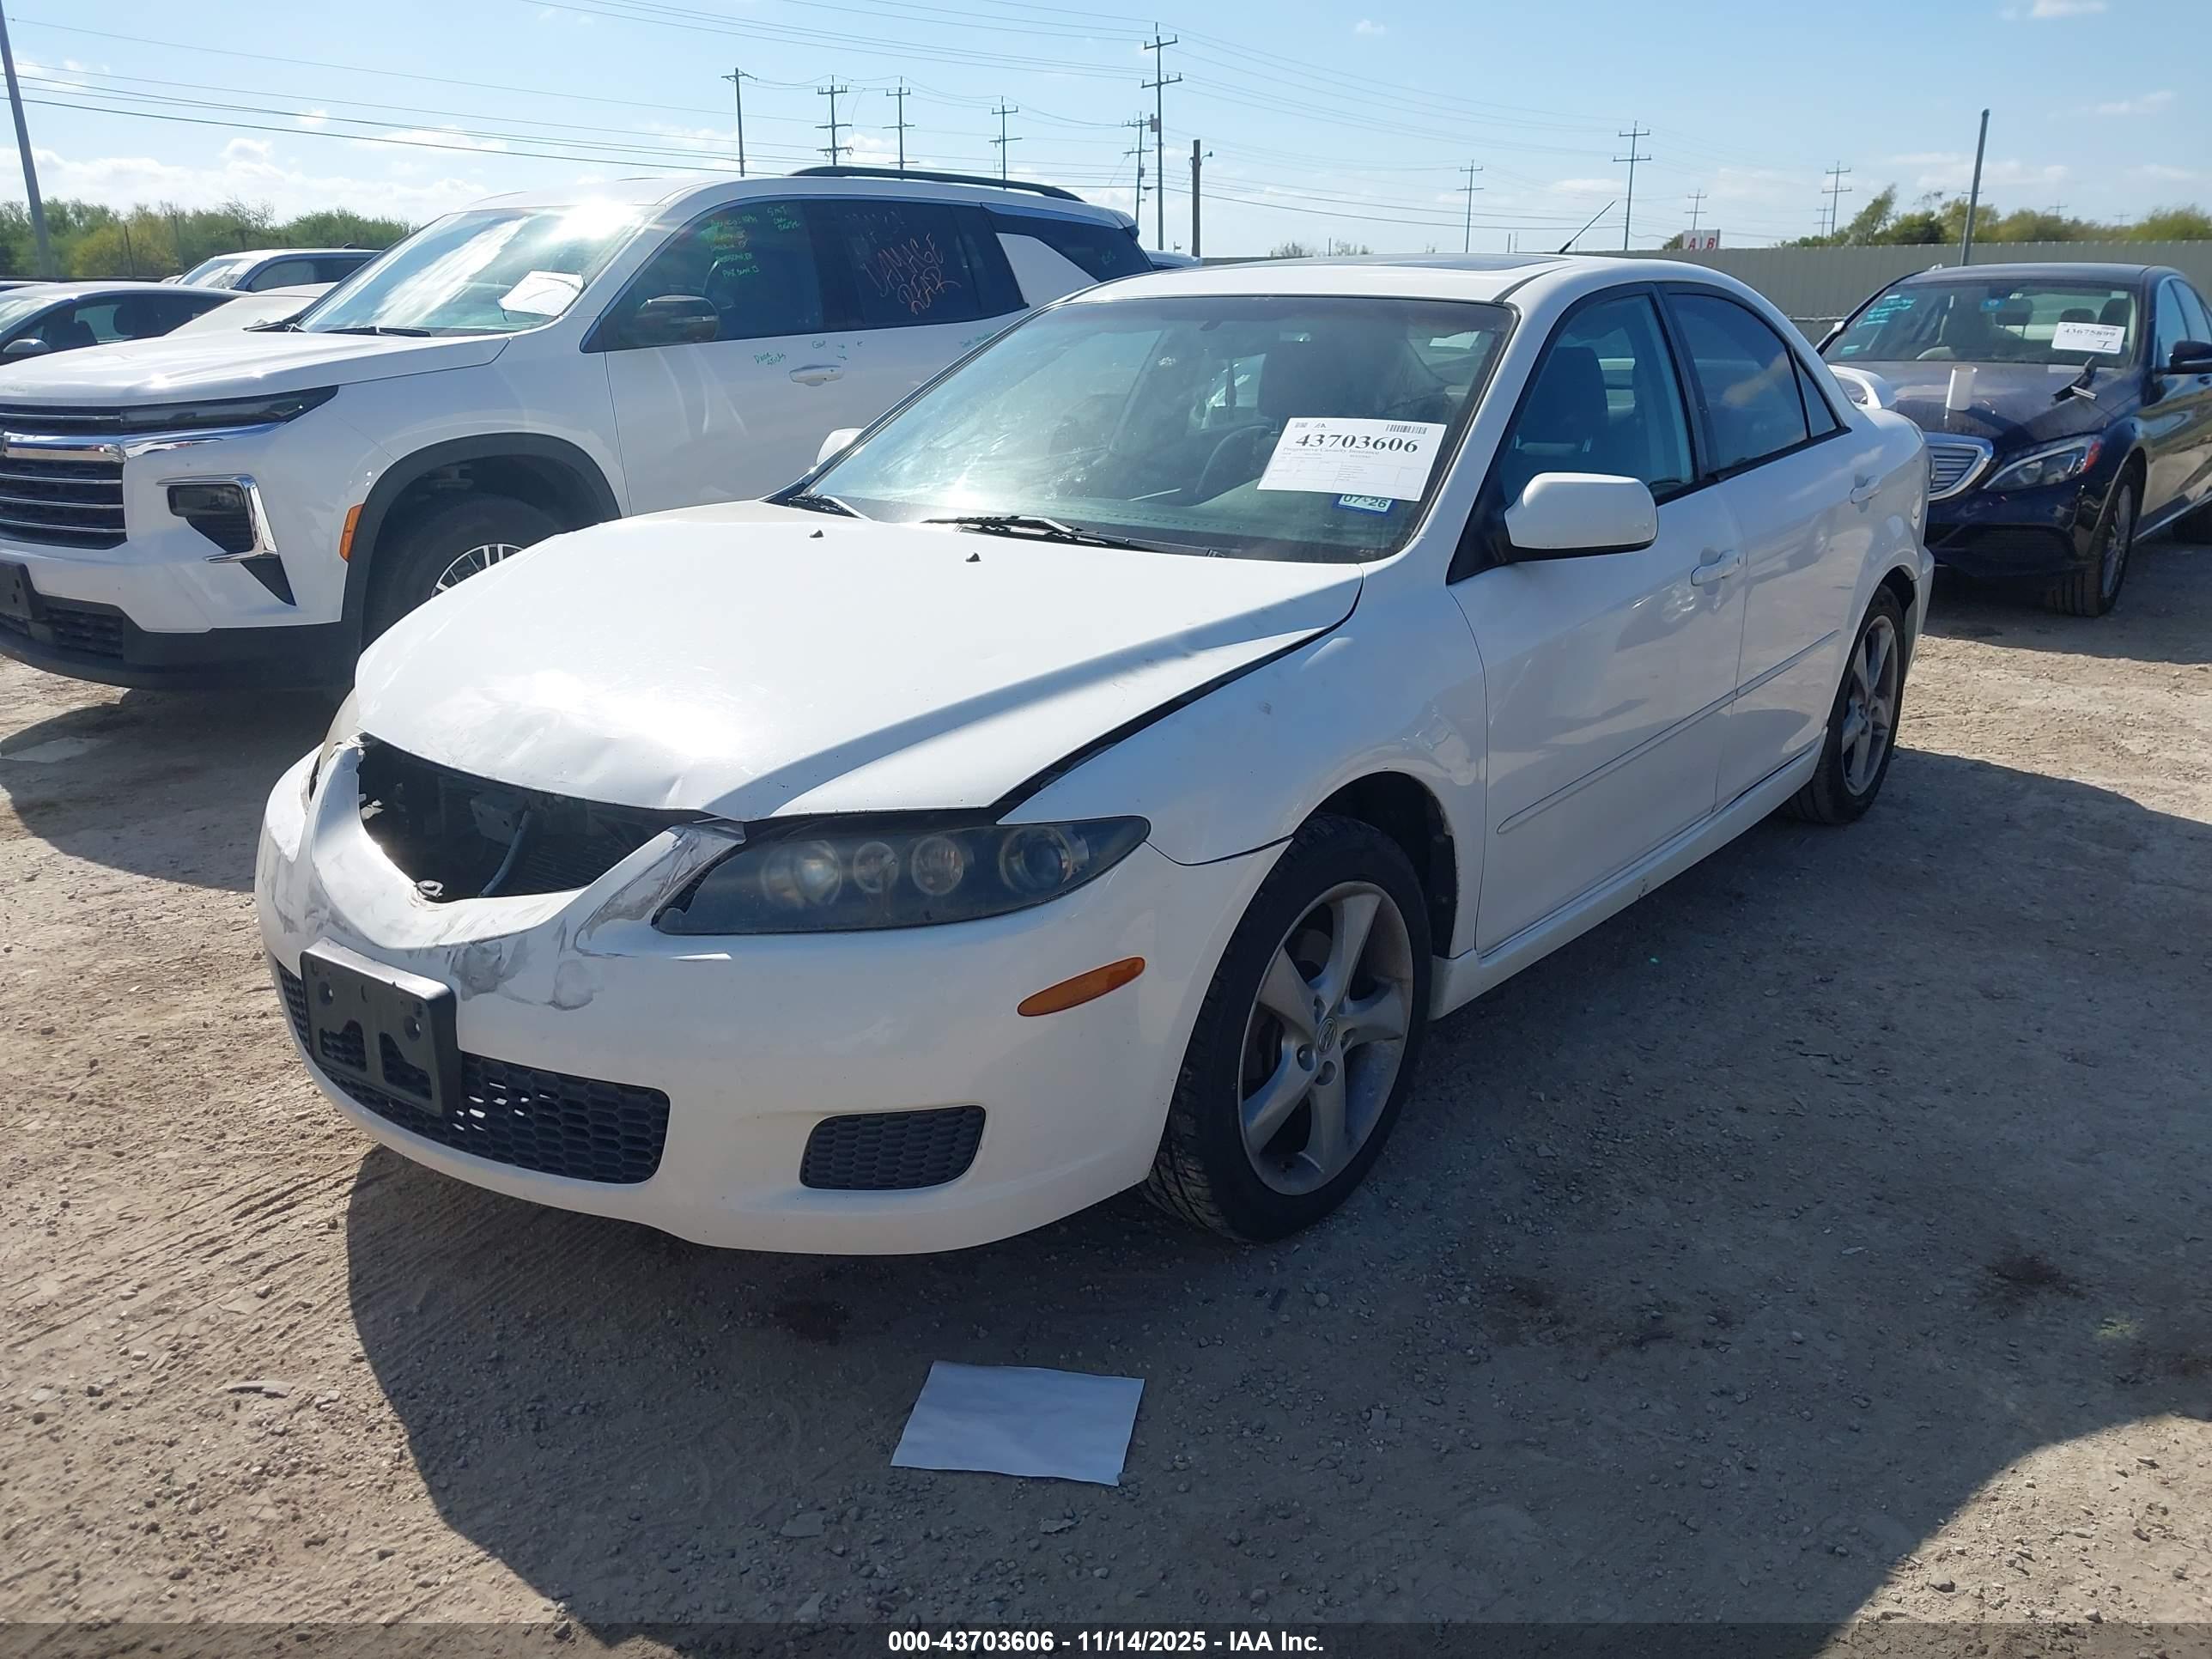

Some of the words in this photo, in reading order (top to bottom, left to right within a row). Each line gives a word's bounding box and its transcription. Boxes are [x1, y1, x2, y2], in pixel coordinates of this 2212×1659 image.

[860, 233, 944, 297] DAMAGE
[897, 266, 962, 315] REAR
[1295, 433, 1421, 453] 43703606
